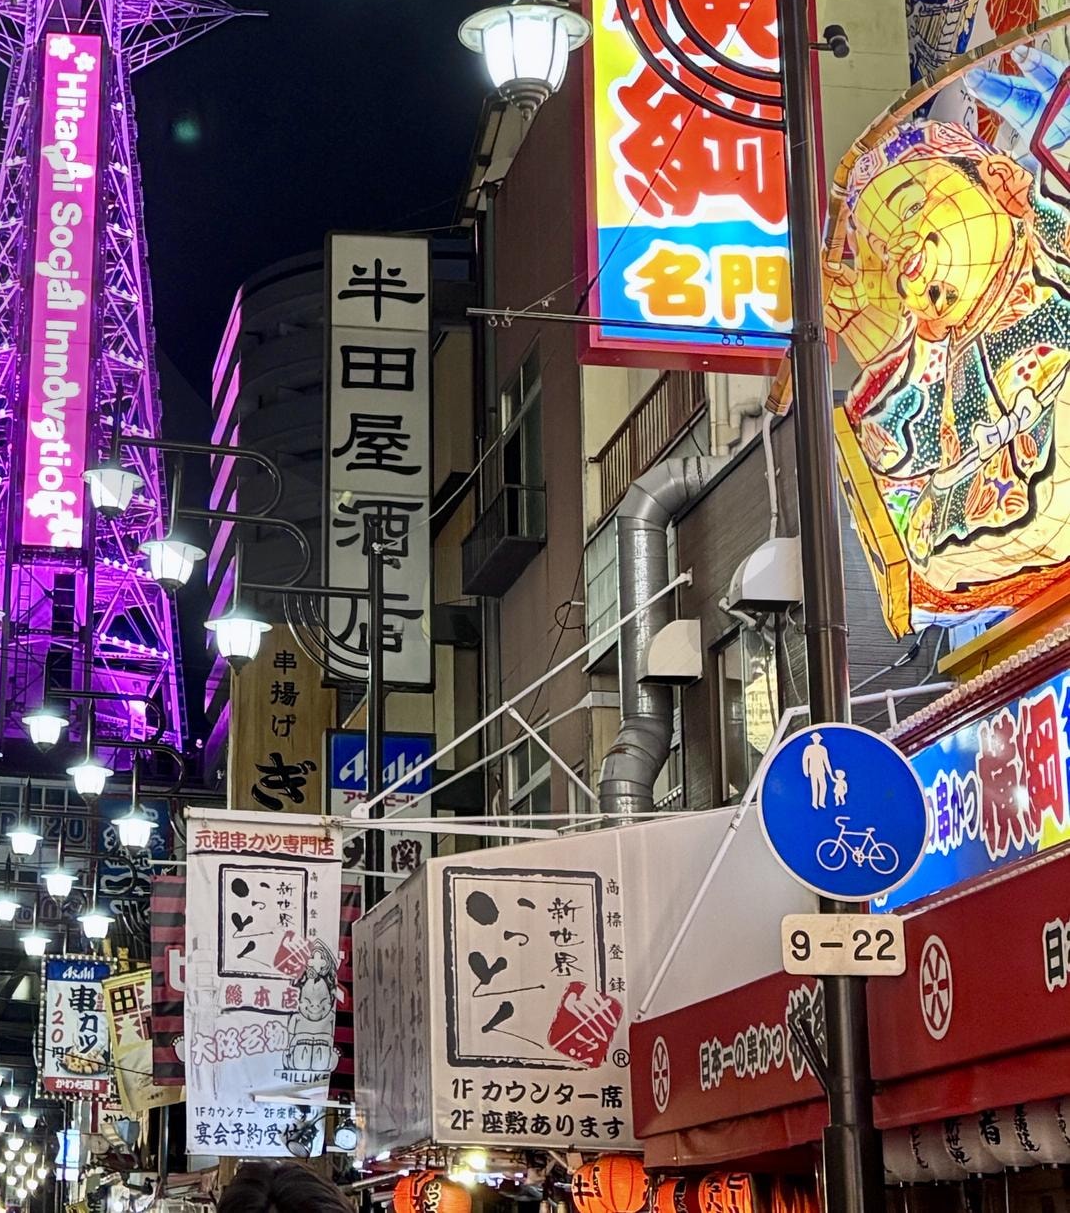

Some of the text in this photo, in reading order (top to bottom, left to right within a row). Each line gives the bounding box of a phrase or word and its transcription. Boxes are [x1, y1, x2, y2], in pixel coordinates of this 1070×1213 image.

[41, 72, 94, 192] Hitachi
[35, 201, 86, 309] Social
[635, 247, 791, 322] 名門
[333, 258, 425, 657] 半田屋酒店
[270, 650, 300, 737] 串揚げ
[195, 830, 335, 856] 元祖串カツ専門店
[275, 881, 296, 928] 新世界
[547, 897, 584, 976] 新世界
[606, 879, 626, 993] 商標登録
[62, 965, 95, 980] Asahi
[465, 890, 546, 1050] いっとく
[68, 984, 98, 1054] 串カツ
[191, 1021, 288, 1065] 大阪名物
[699, 1022, 785, 1092] 日本一の串かつ
[451, 1108, 624, 1139] 2F 座敷あります
[452, 1078, 623, 1109] 1F カウンター席
